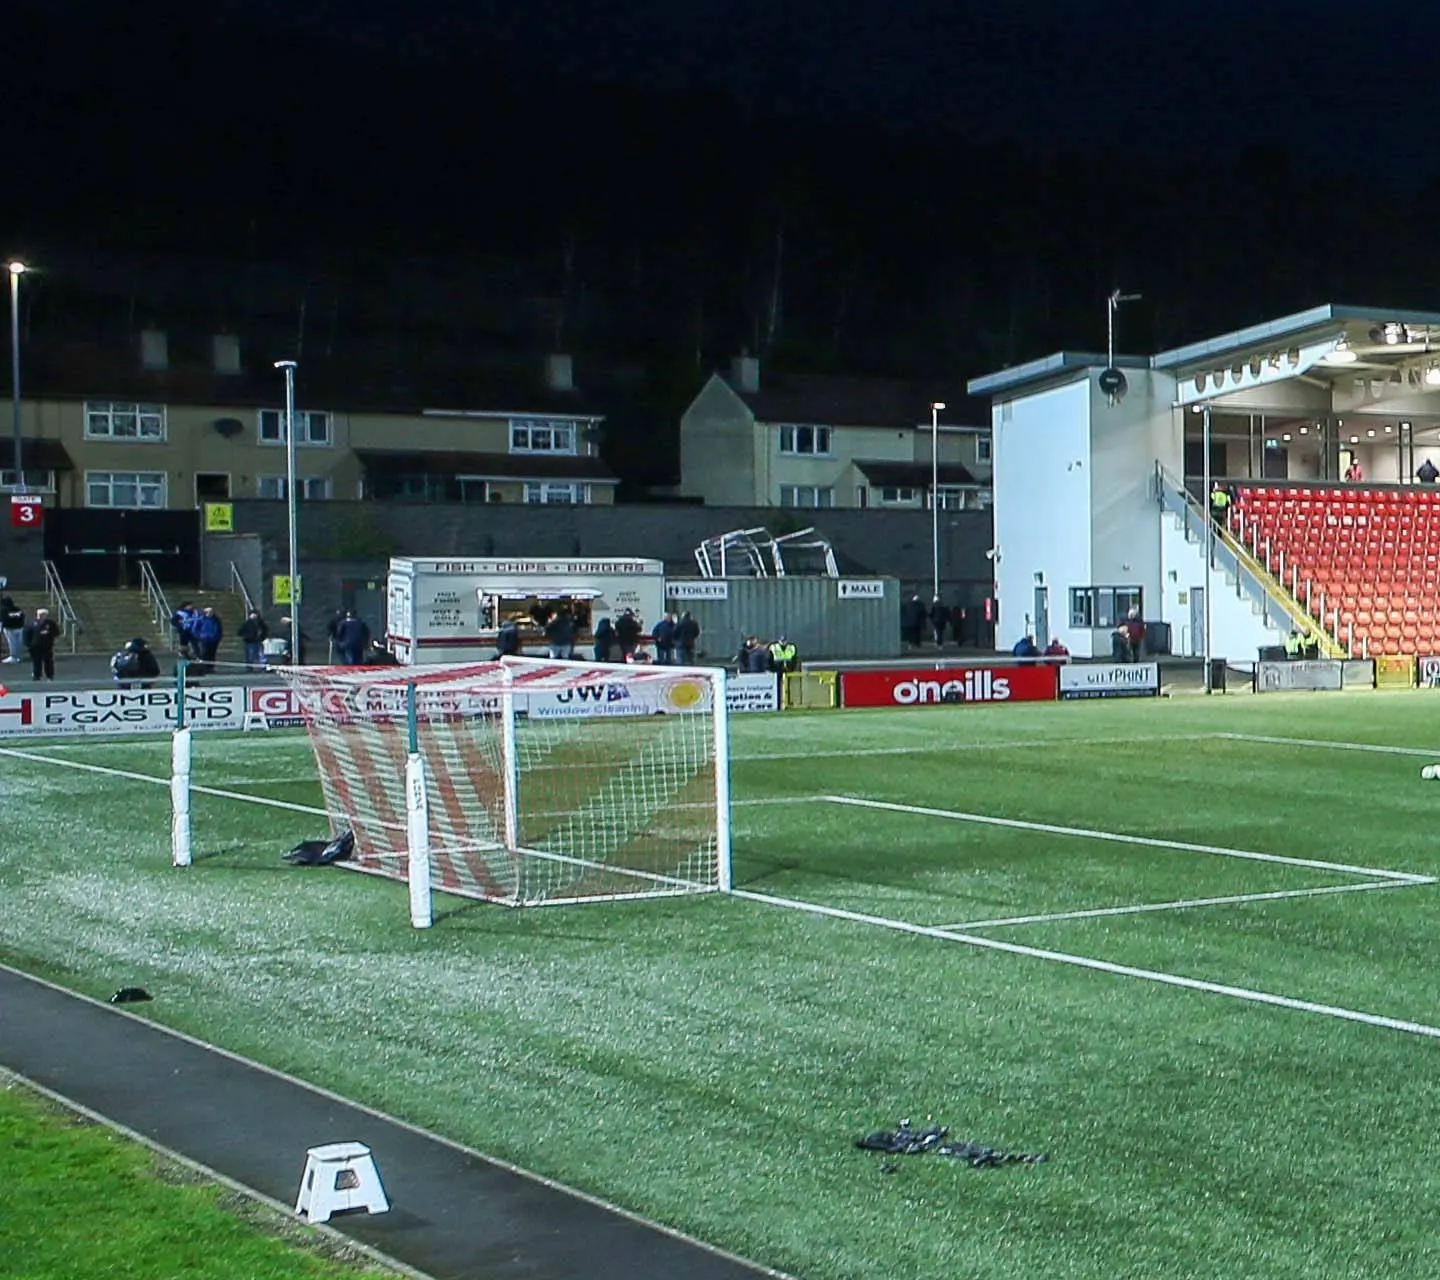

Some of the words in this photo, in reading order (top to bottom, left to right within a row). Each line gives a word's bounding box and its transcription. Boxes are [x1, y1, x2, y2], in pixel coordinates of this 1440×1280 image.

[20, 506, 35, 522] 3
[435, 563, 474, 571] FISH
[497, 563, 546, 571] CHIPS
[568, 563, 644, 572] BURGERS
[682, 586, 726, 595] TOILETS
[851, 584, 881, 593] MALE
[46, 691, 233, 708] PLUMBING
[46, 712, 66, 724] &
[72, 708, 148, 723] GAS
[165, 706, 232, 719] LTD
